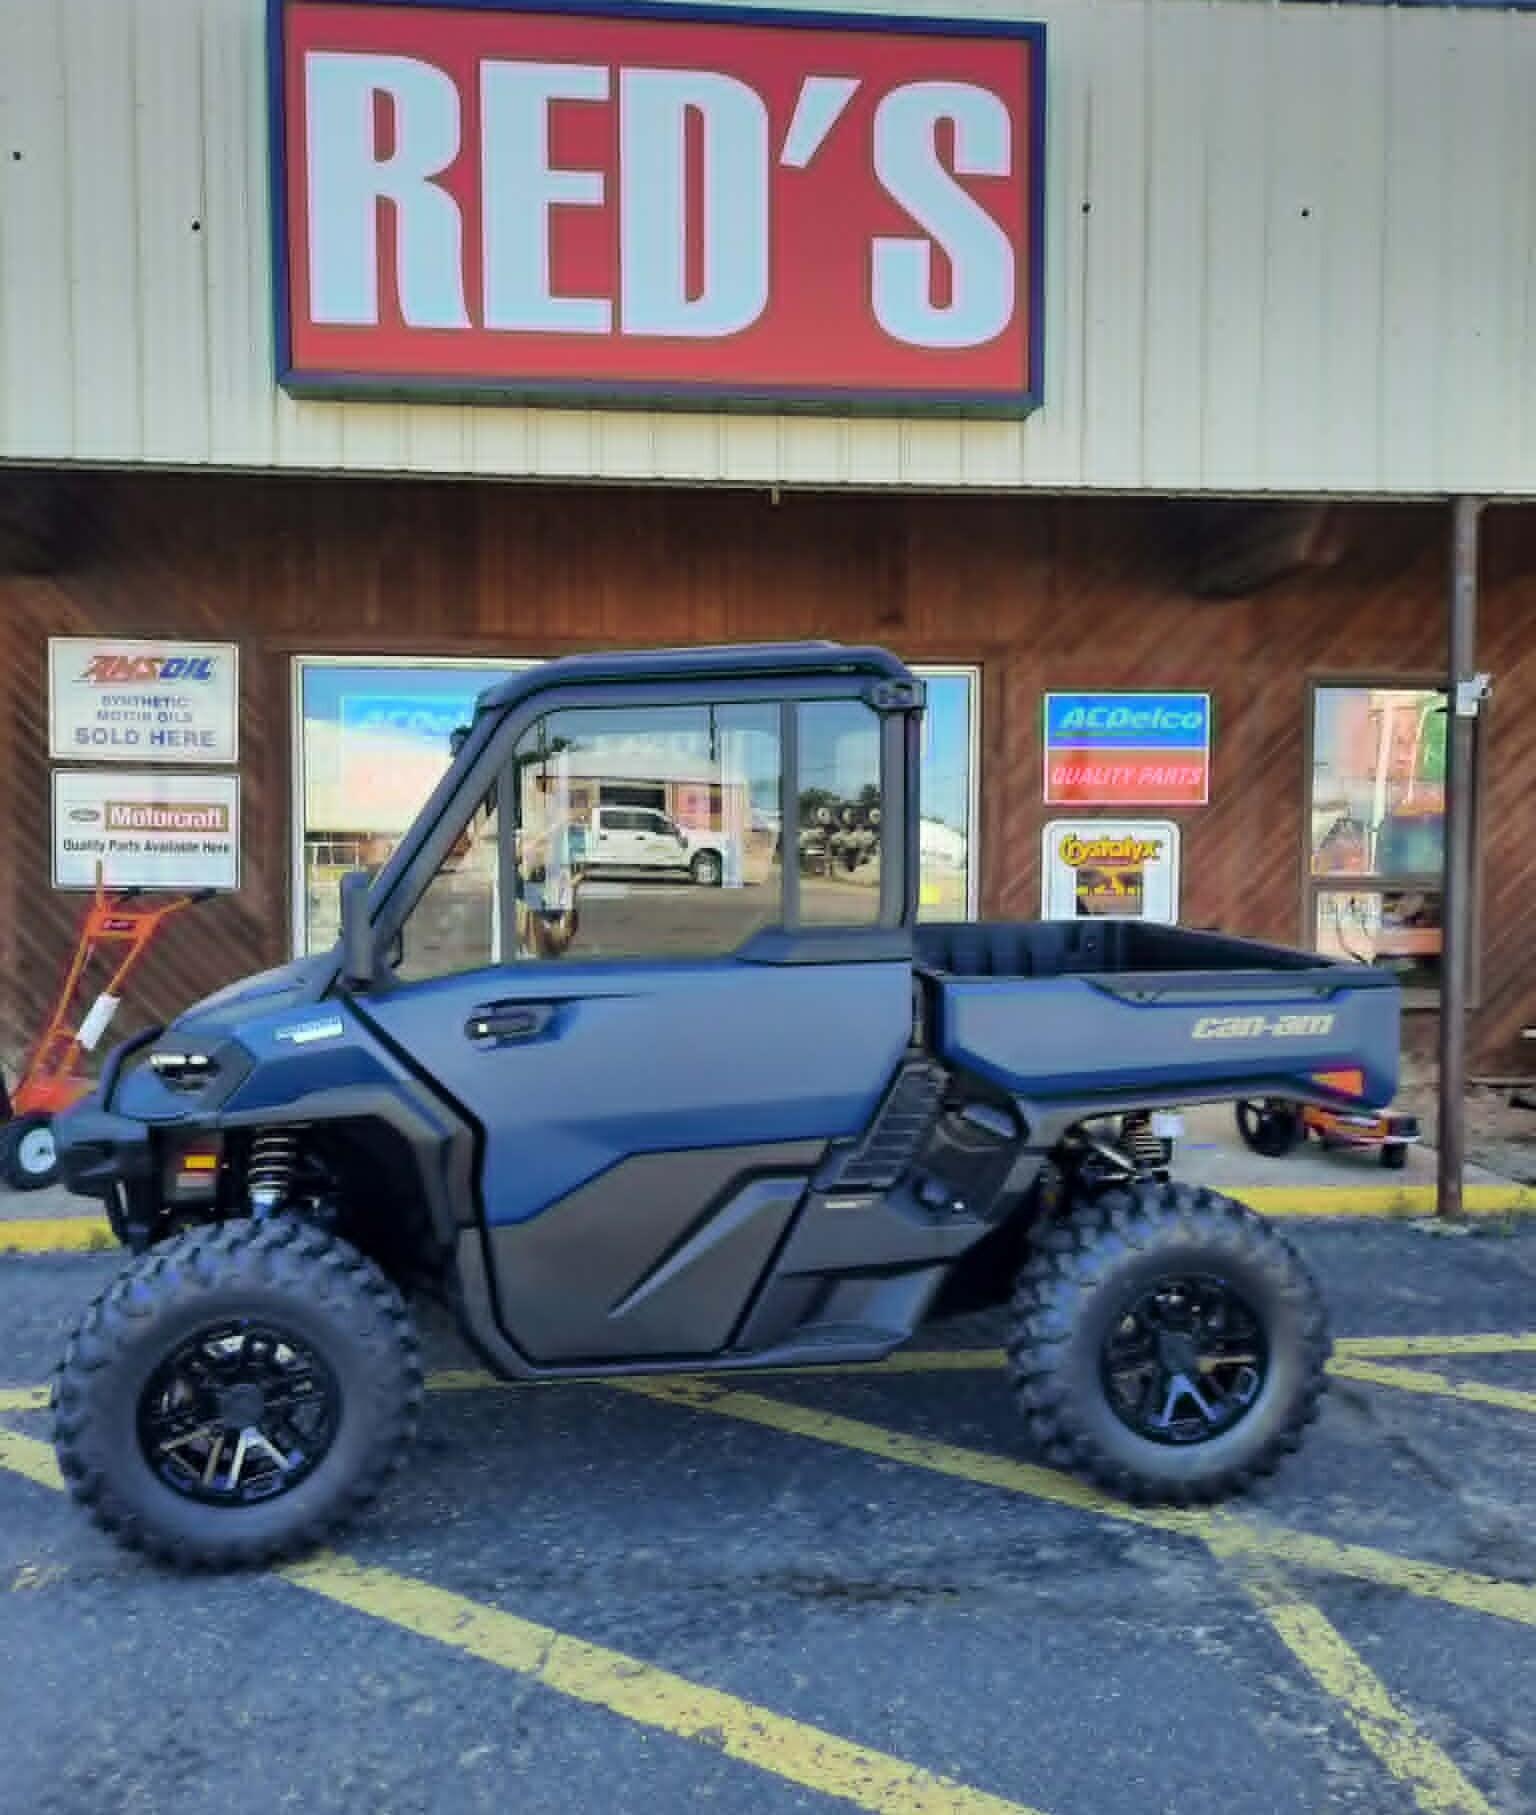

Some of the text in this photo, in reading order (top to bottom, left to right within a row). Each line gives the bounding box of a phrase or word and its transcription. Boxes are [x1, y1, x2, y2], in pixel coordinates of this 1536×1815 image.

[305, 50, 1016, 349] RED'S
[80, 655, 217, 681] AMSOIL
[1060, 706, 1204, 729] ACDelco
[75, 727, 217, 748] SOLD HERE
[1053, 767, 1204, 785] QUALITY PARTS
[63, 839, 105, 853] Quality
[108, 840, 140, 852] Parts
[1191, 1013, 1335, 1041] can-am
